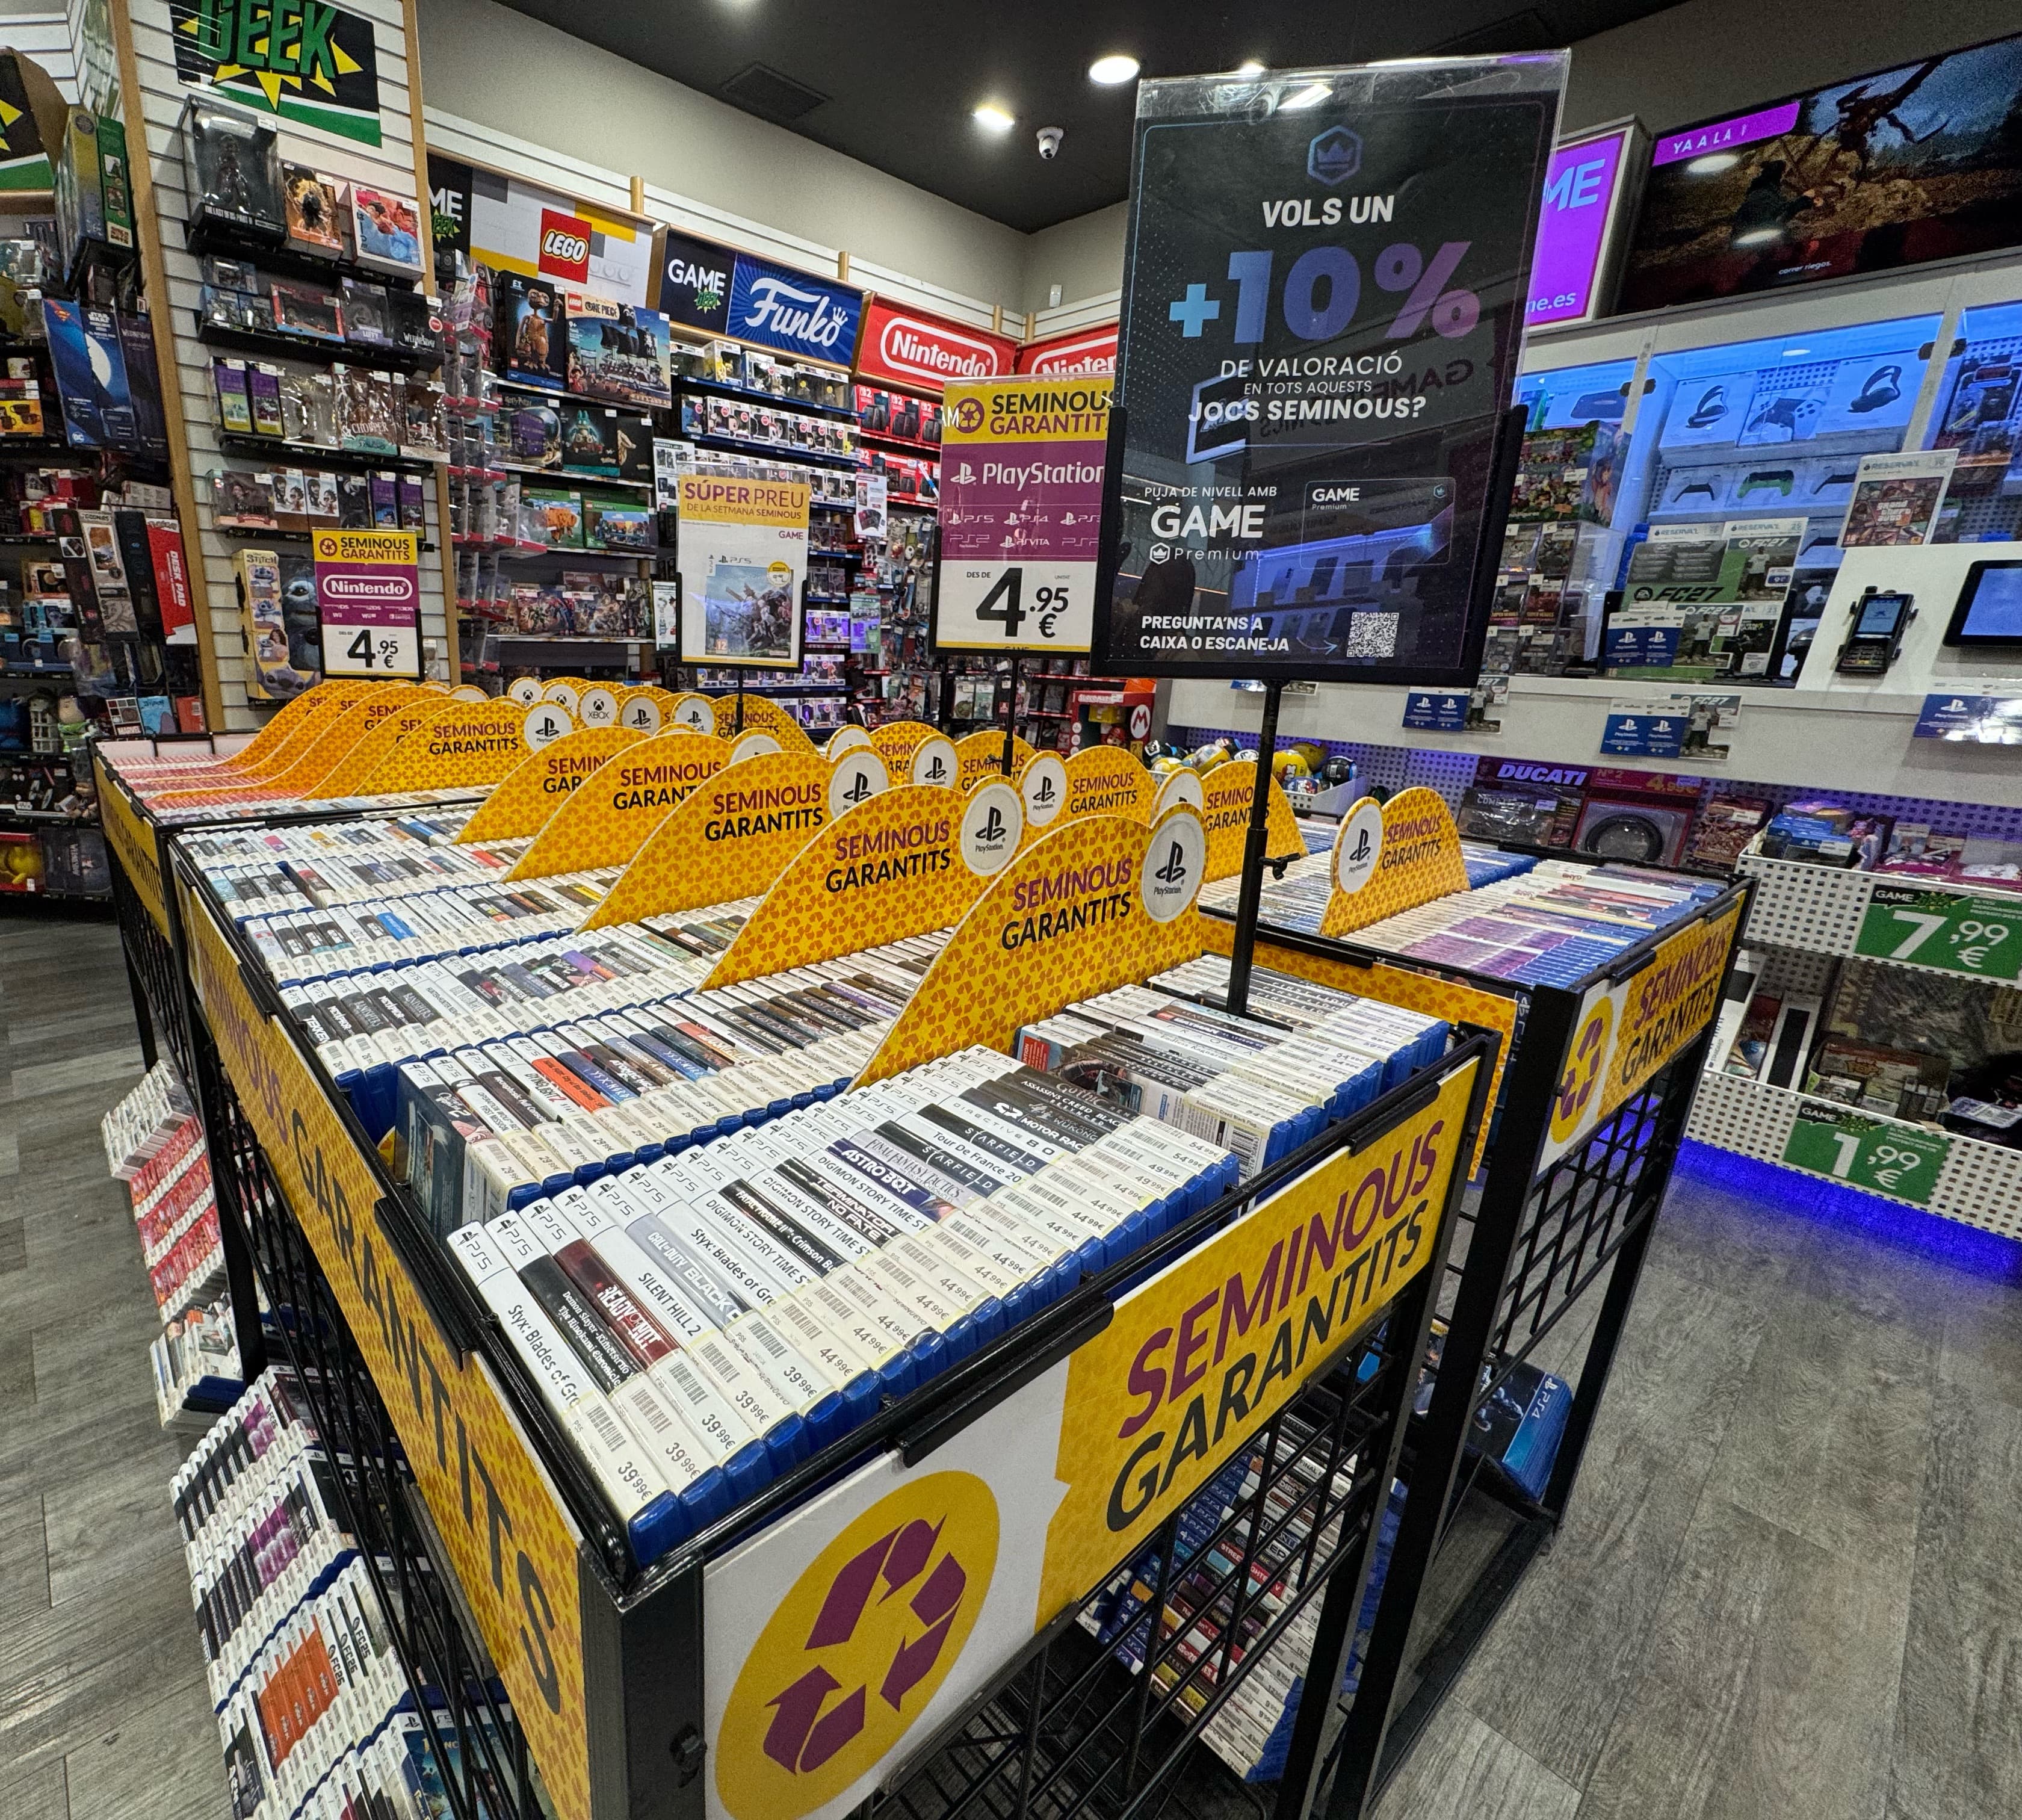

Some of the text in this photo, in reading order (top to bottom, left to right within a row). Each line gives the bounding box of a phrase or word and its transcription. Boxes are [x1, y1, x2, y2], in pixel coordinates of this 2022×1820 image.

[197, 0, 338, 78] GEEK
[1543, 158, 1606, 212] ME
[428, 188, 463, 221] ME
[1262, 195, 1394, 228] VOLS UN
[543, 232, 587, 262] LEGO
[668, 259, 726, 296] GAME
[696, 291, 719, 308] GEEK
[1170, 242, 1480, 344] +10%
[744, 277, 842, 347] Funko
[891, 330, 988, 377] Nintendo
[1220, 350, 1403, 379] DE VALORACIÓ
[992, 391, 1114, 414] SEMINOU
[1244, 380, 1372, 395] EN TOTS AQUESTS
[990, 413, 1108, 435] GARANTIT
[1189, 396, 1427, 422] JOCS SEMINOUS?
[685, 480, 803, 508] SÚPER PREU
[1145, 486, 1278, 498] PUJA DE NIVELL AMB
[1312, 488, 1360, 502] GAME
[687, 503, 802, 519] DE LA SETMANA SEMINOUS
[964, 515, 994, 523] PS5
[1151, 505, 1266, 539] GAME
[340, 537, 410, 549] SEMINOUS
[779, 530, 804, 540] GAME
[341, 549, 410, 560] GARANTITS
[1175, 548, 1260, 561] Premium
[332, 581, 405, 595] Nintendo
[1038, 613, 1057, 638] €
[1142, 616, 1263, 632] PREGUNTA'NS A
[1140, 636, 1289, 652] CAIXA O ESCANEJA
[384, 655, 394, 668] €
[429, 737, 519, 755] GARANTITS
[433, 723, 516, 739] SEMINOUS
[620, 762, 722, 787] SEMINOUS
[1072, 772, 1135, 794] SEMINOUS
[1497, 764, 1589, 786] DUCATI
[613, 785, 699, 810] GARANT
[714, 783, 821, 816] SEMINOUS
[1070, 792, 1137, 814] GARANTITS
[1207, 786, 1254, 810] SEMINO
[705, 808, 824, 842] GARANTITS
[1387, 816, 1441, 844] SEMINOUS
[835, 820, 950, 861] SEMINOUS
[975, 843, 1004, 853] PlayStation
[1382, 838, 1441, 870] GARANTITS
[826, 849, 951, 892] GARANTITS
[1014, 858, 1132, 911] SEMINOUS
[1154, 885, 1183, 895] PlayStation
[1875, 890, 1915, 902] GAME
[1003, 891, 1131, 950] GARANTITS
[1957, 946, 1989, 968] €
[1633, 922, 1731, 1030] SEMINOUS
[1622, 973, 1717, 1085] GARANTITS
[1062, 1098, 1093, 1114] CREED
[1802, 1107, 1836, 1121] GAME
[1021, 1116, 1060, 1140] MOTOR
[1053, 1117, 1098, 1142] WUKONG
[933, 1131, 1005, 1177] Tour De France
[964, 1127, 1036, 1169] STARFIELD
[841, 1149, 917, 1195] ASTRO BOT
[922, 1145, 995, 1189] STARFIELD
[1873, 1169, 1903, 1189] €
[818, 1156, 914, 1224] DIGIMON STORY TIME
[924, 1169, 965, 1199] TACTICS
[815, 1177, 897, 1233] TERMINATOR
[826, 1199, 883, 1240] NO FATE
[705, 1198, 800, 1281] DIGIMON STORY TIME
[791, 1234, 827, 1266] Crimson
[467, 1240, 492, 1271] PS5
[691, 1228, 759, 1290] Styx: Blades of
[647, 1231, 732, 1311] CALL DUTY BLACK
[1118, 1120, 1444, 1439] SEMINOUS
[562, 1291, 598, 1336] Demon Slayer
[596, 1284, 633, 1323] READY
[629, 1320, 661, 1349] NOT
[638, 1272, 702, 1337] SILENT HILL 2
[508, 1304, 570, 1385] Styx: Blades of
[558, 1306, 594, 1354] The Hinokami
[1106, 1199, 1430, 1532] GARANTITS
[292, 1109, 560, 1715] GARANTITS
